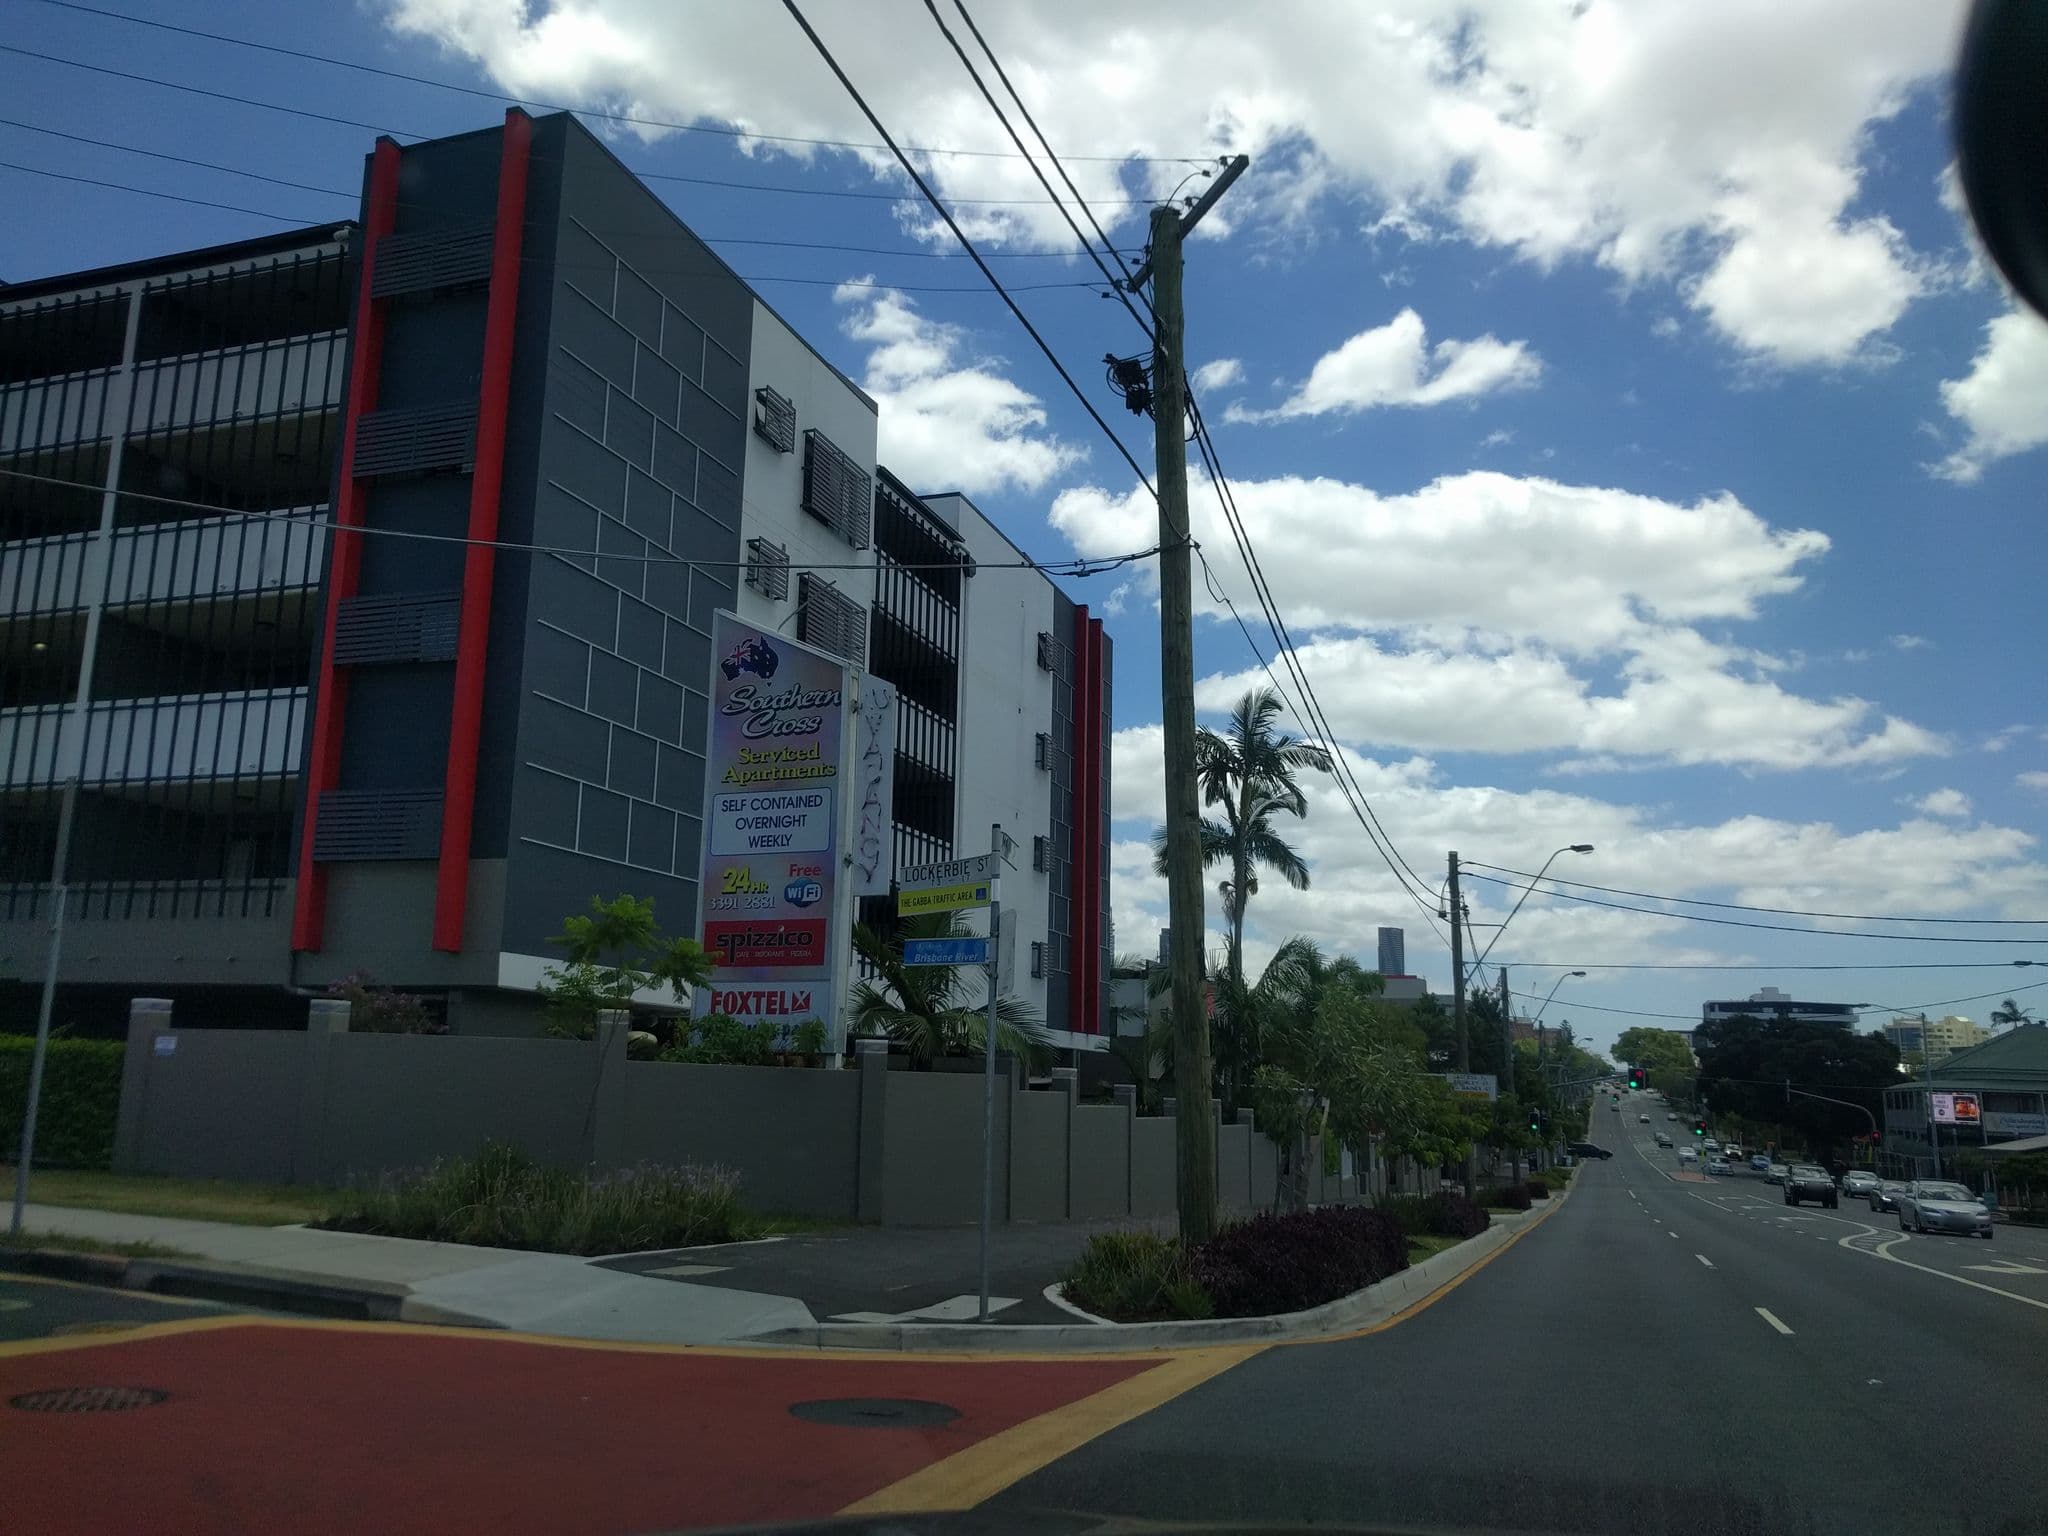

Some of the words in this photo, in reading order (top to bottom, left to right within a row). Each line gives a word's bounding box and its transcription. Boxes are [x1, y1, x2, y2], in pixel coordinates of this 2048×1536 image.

[721, 683, 842, 716] Southern
[741, 710, 823, 739] Cross
[738, 742, 820, 765] Serviced
[721, 763, 837, 787] Apartments
[721, 799, 747, 812] SELF
[750, 795, 823, 811] CONTAINED
[735, 814, 808, 830] OVERNIGHT
[748, 834, 793, 849] WEEKLY
[721, 865, 751, 895] 24
[751, 882, 769, 895] HR
[789, 864, 822, 877] Free
[904, 860, 971, 883] LOCKERBIE
[977, 858, 990, 872] ST
[787, 885, 803, 899] Wi
[804, 885, 821, 899] Fi
[902, 898, 912, 908] THE
[912, 896, 932, 907] GABBA
[933, 893, 956, 905] TRAFFIC
[957, 891, 973, 902] AREA
[709, 896, 741, 911] 3391
[744, 896, 776, 910] 2881
[716, 925, 814, 963] spizzico
[914, 953, 953, 963] Brisbane
[955, 952, 978, 962] River
[710, 990, 790, 1015] FOXTEL
